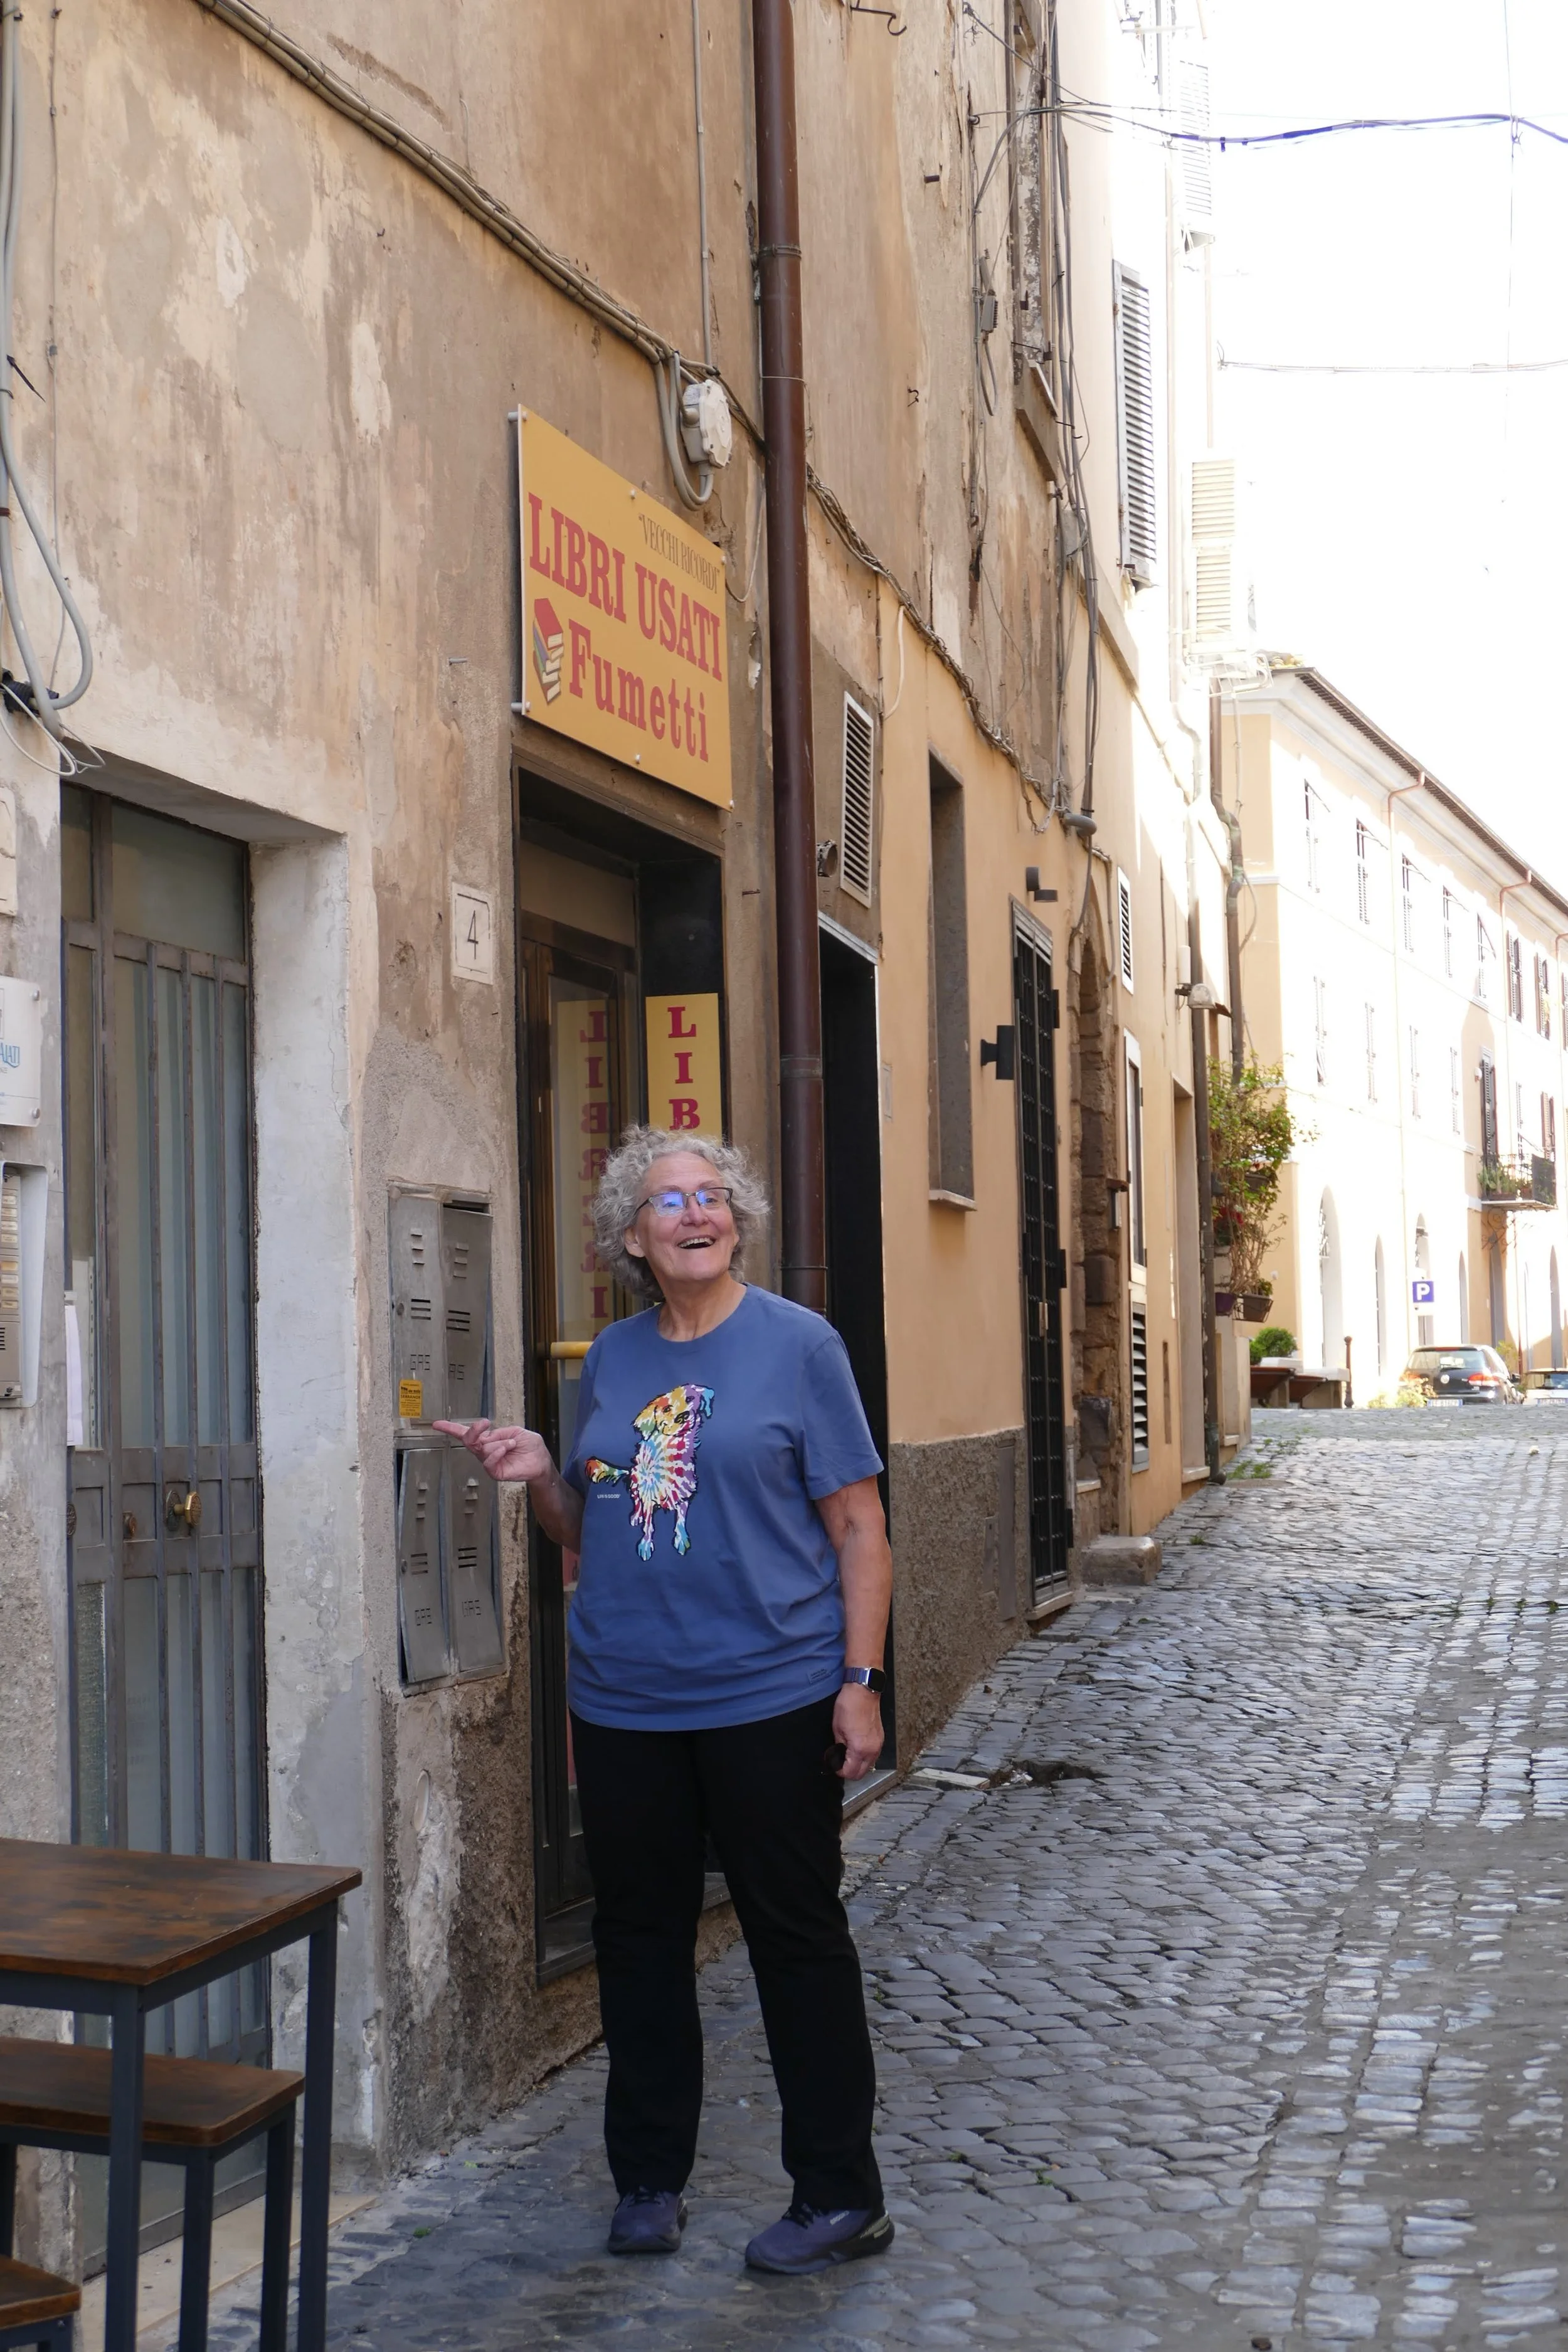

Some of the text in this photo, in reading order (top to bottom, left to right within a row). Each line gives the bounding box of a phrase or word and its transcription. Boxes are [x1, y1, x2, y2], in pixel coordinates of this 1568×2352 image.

[528, 492, 722, 682] LIBRI USATI
[568, 618, 709, 763] Fumetti
[467, 910, 479, 960] 4
[1417, 1283, 1430, 1300] P
[410, 1354, 430, 1371] GAS
